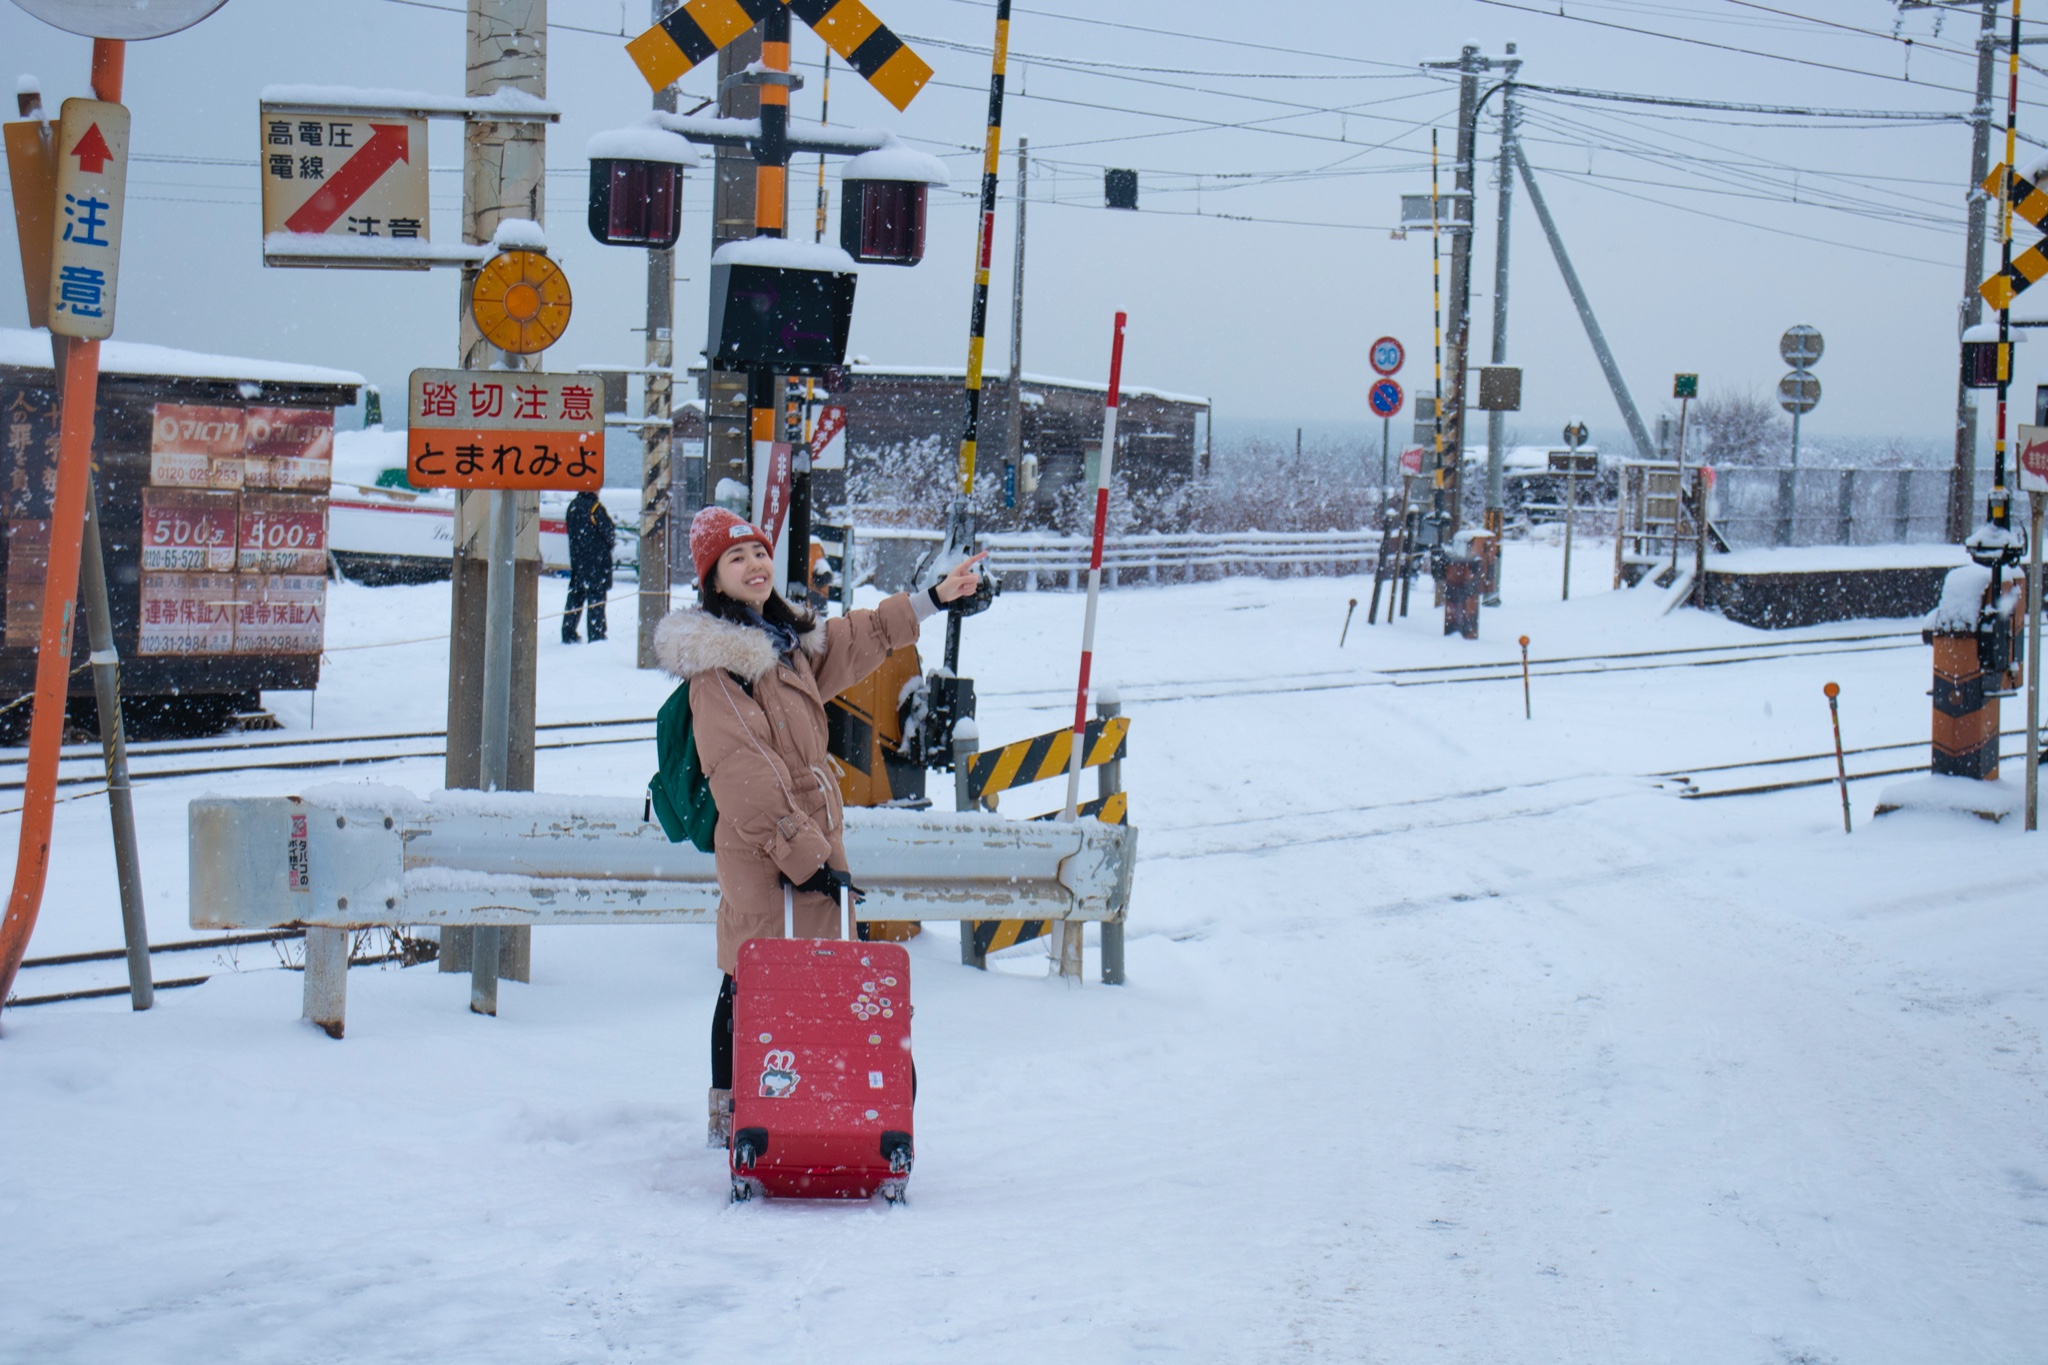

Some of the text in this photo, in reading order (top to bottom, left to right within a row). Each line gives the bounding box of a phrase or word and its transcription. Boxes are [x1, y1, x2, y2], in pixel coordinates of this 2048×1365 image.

[267, 120, 354, 147] 高電圧
[268, 154, 325, 179] 電線
[56, 193, 110, 318] 注意
[1377, 347, 1398, 365] 30
[421, 381, 595, 420] 踏切注意
[415, 442, 597, 477] とまれみよ
[145, 600, 230, 625] 連帯保証人
[240, 601, 321, 625] 連帯保証人
[141, 636, 207, 652] 0120-31-2984
[299, 840, 309, 885] タバコの
